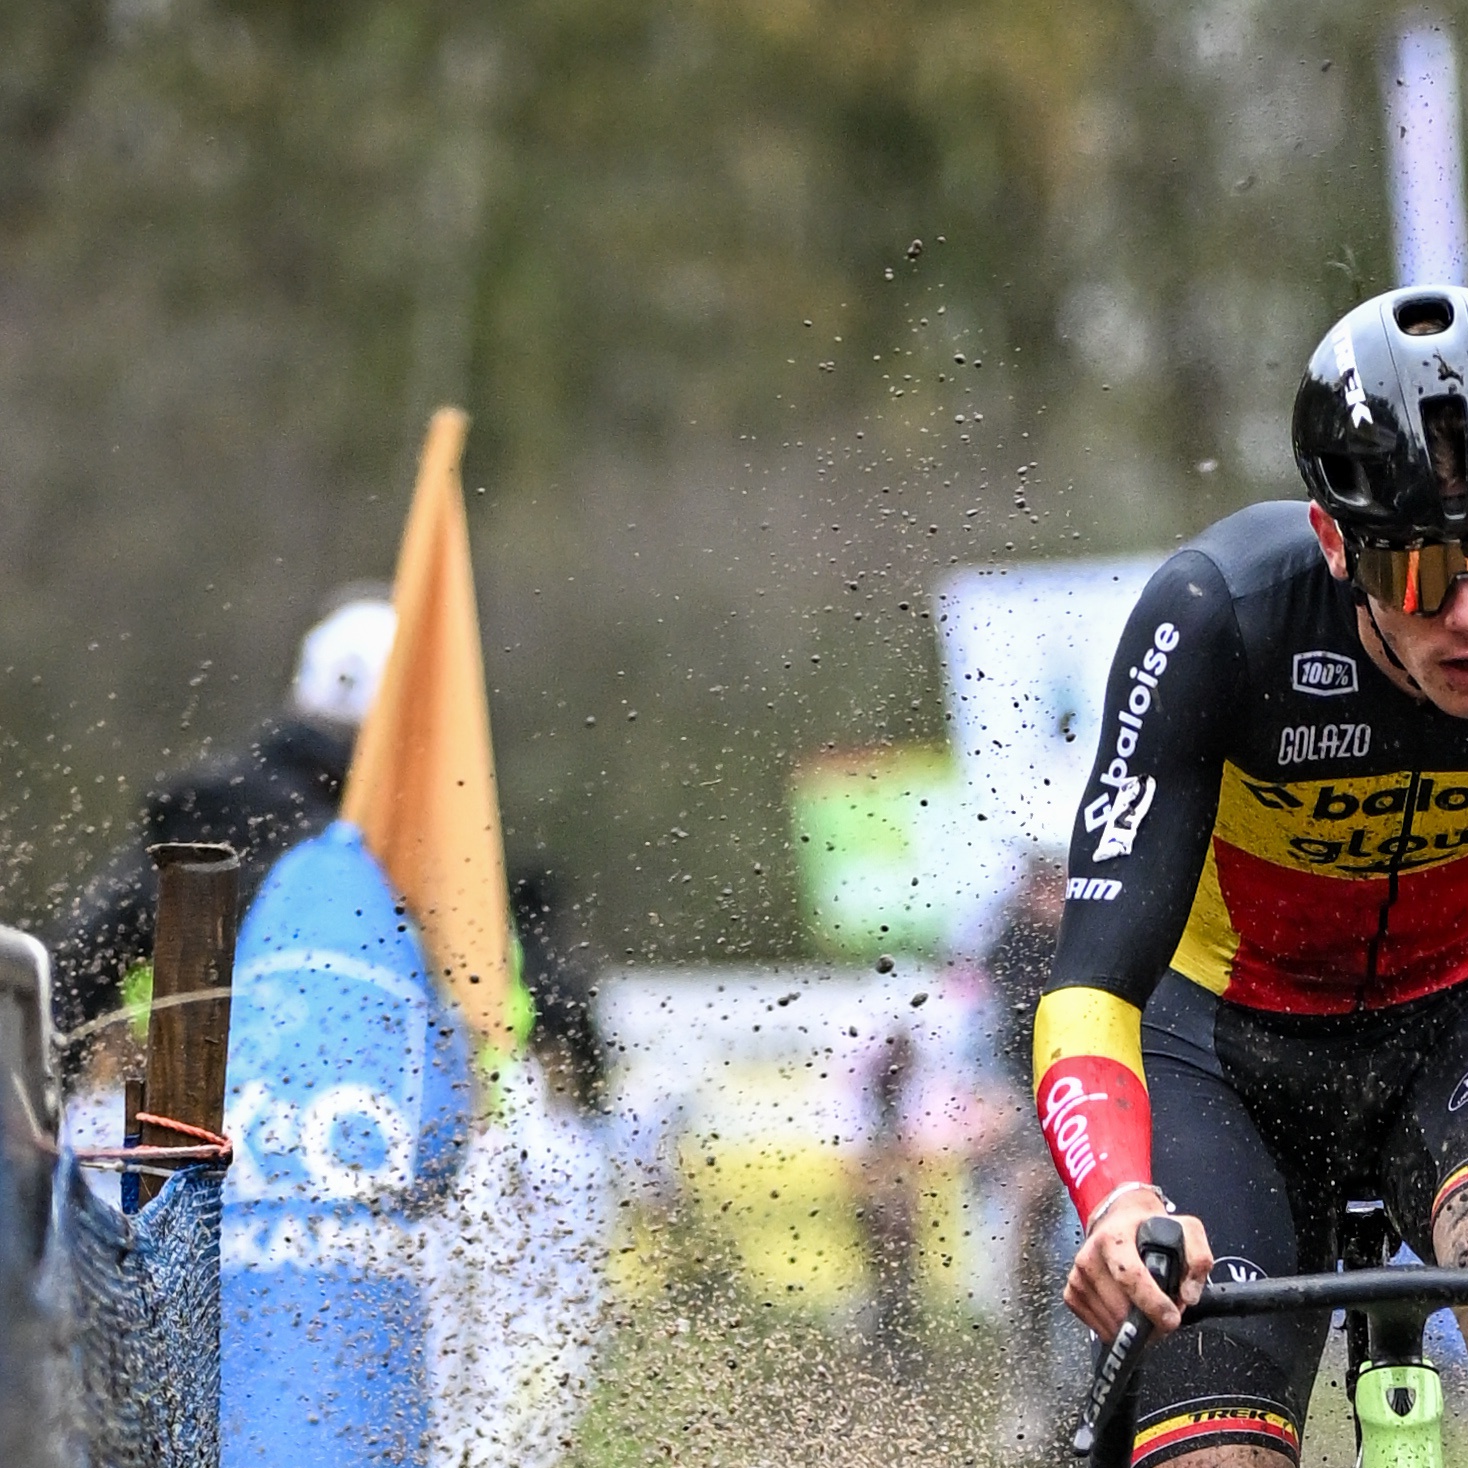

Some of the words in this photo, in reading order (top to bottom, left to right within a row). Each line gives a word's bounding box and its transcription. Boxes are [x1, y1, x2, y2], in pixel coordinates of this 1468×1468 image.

[1300, 660, 1349, 686] 100%
[1100, 621, 1181, 788] baloise
[1277, 723, 1372, 766] GOLAZO
[1065, 877, 1123, 900] AM
[1042, 1076, 1109, 1189] glowi
[1187, 1408, 1270, 1423] TREK
